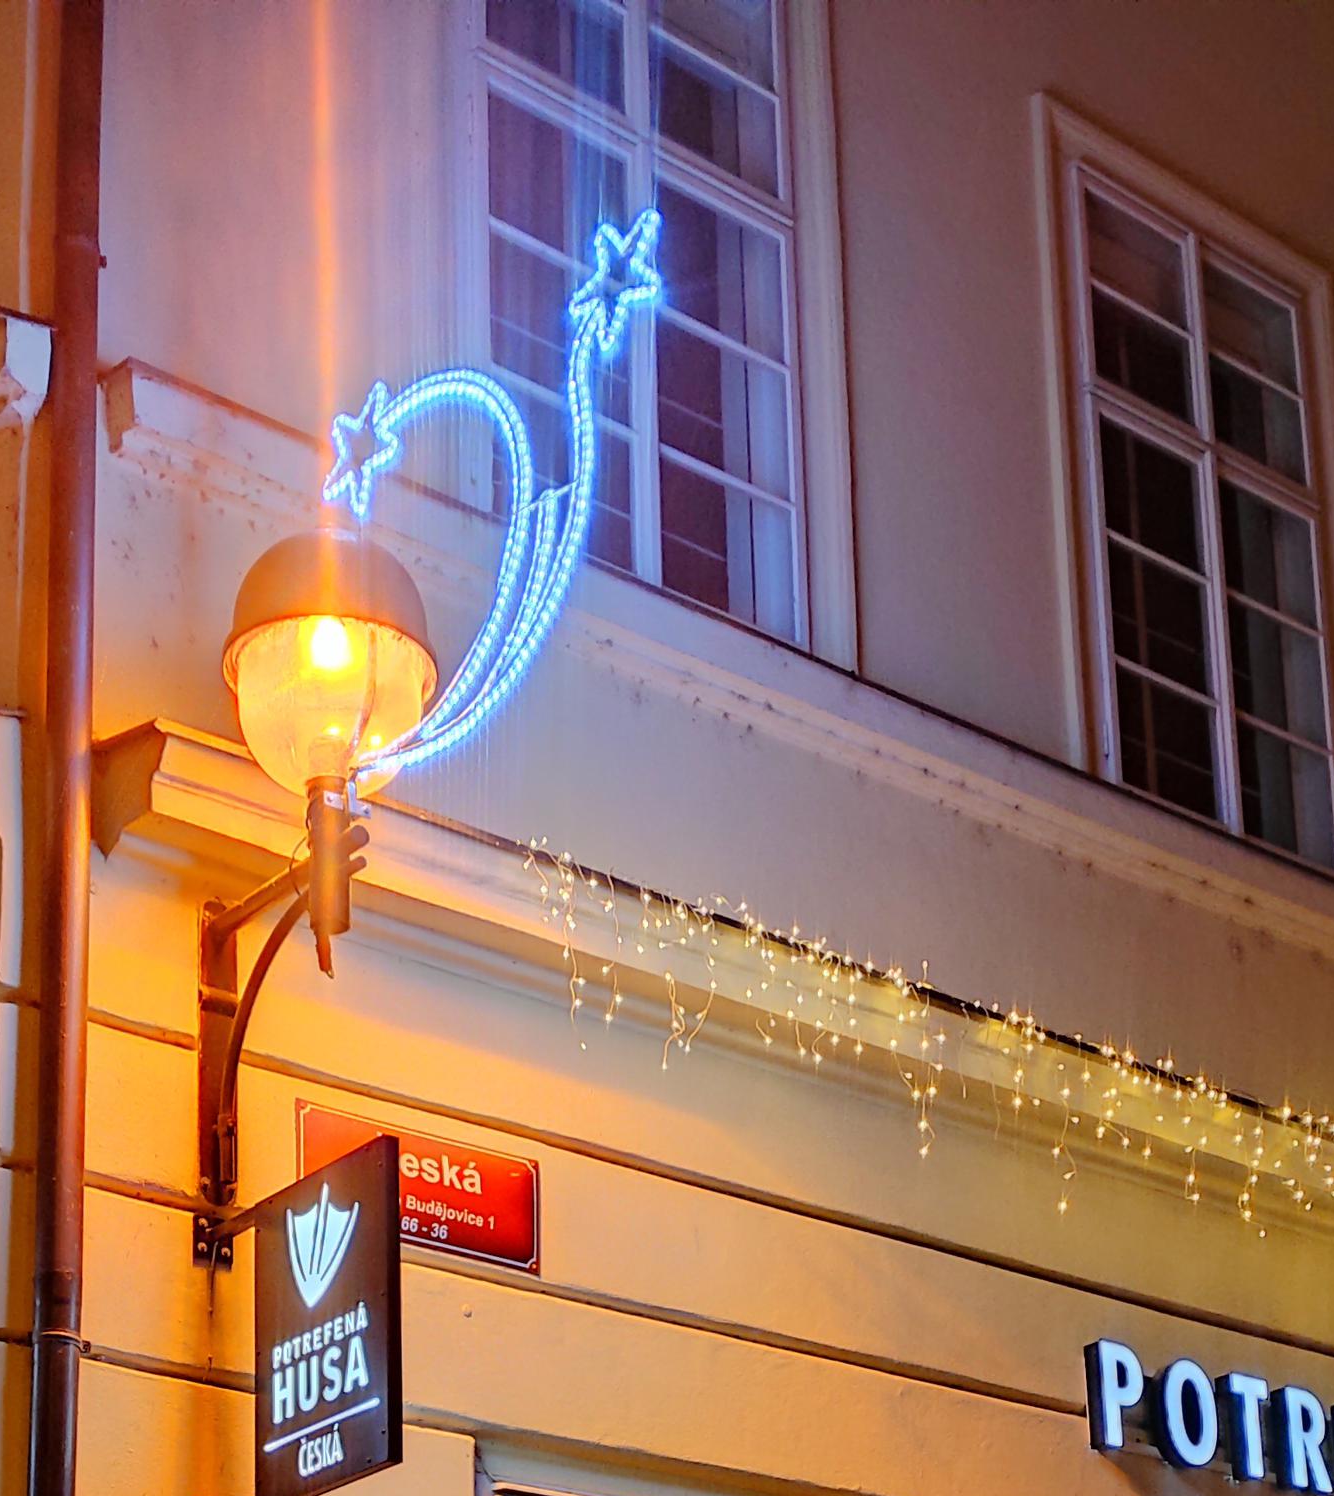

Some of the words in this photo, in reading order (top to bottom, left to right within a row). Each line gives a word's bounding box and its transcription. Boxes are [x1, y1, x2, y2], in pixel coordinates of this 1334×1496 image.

[399, 1152, 482, 1195] eská
[400, 1216, 418, 1233] 66
[430, 1223, 448, 1239] 36
[405, 1194, 484, 1227] Budějovice
[487, 1215, 495, 1230] 1
[273, 1301, 368, 1370] POTREFENÁ
[272, 1335, 369, 1425] HUSA
[298, 1423, 344, 1478] ČESKÁ
